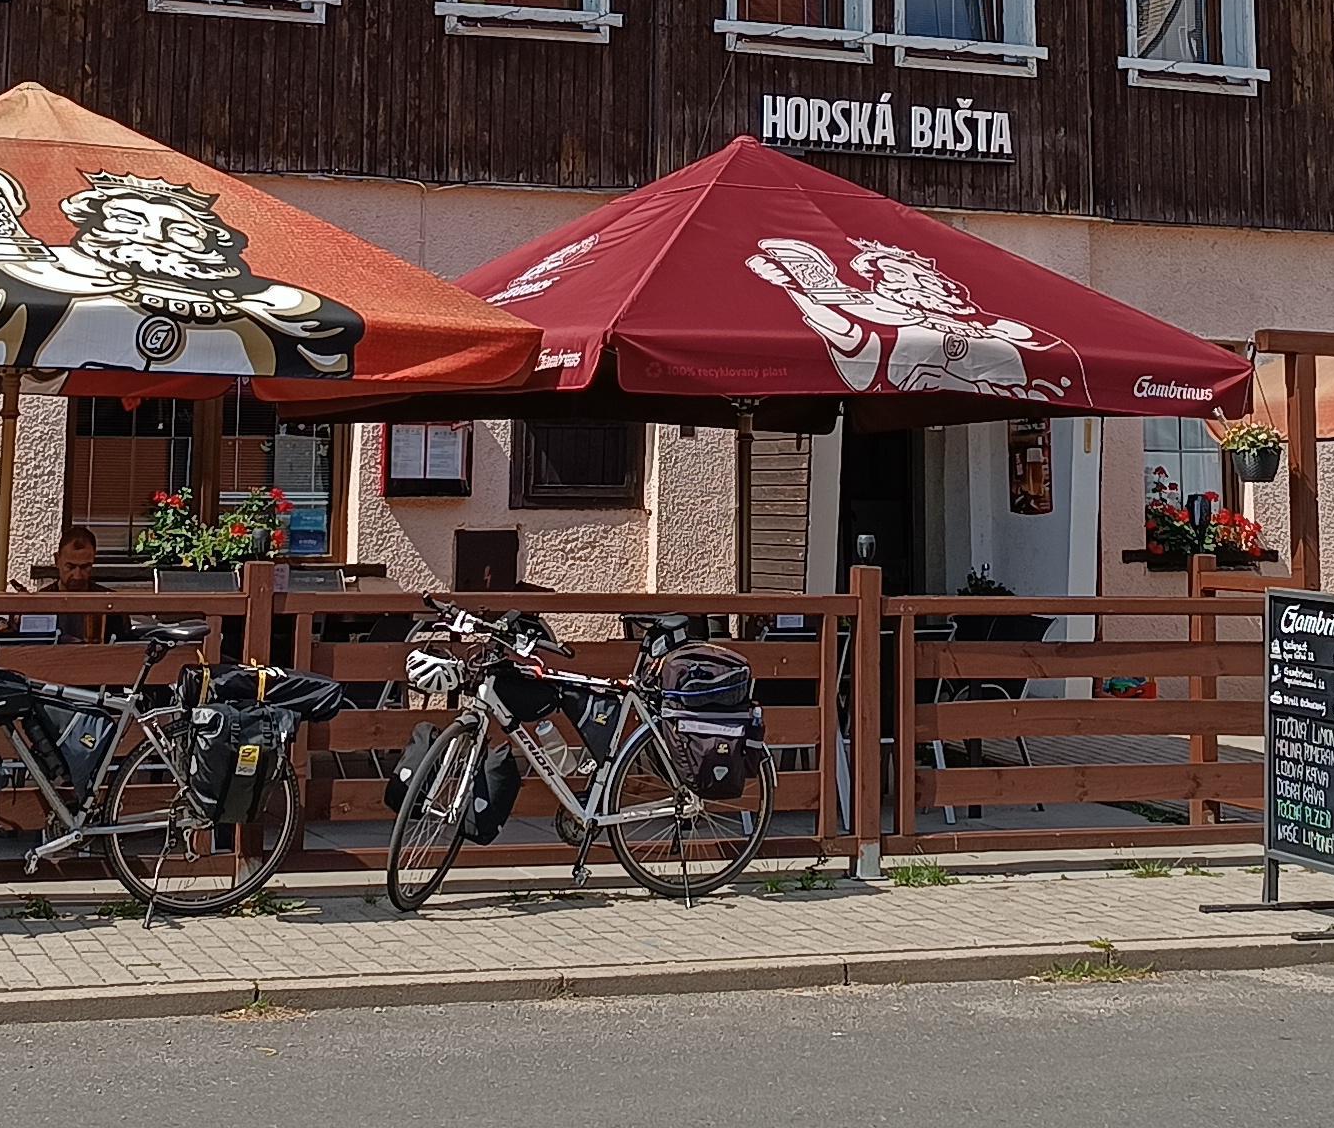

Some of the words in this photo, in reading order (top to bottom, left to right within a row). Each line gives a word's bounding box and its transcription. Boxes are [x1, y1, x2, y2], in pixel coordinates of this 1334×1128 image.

[763, 92, 896, 147] HORSKÁ
[911, 98, 1012, 154] BAŠTA
[698, 365, 759, 378] recyklovaný
[762, 366, 788, 378] plast
[1133, 375, 1213, 401] Gambrinus
[515, 730, 555, 777] ERIDA
